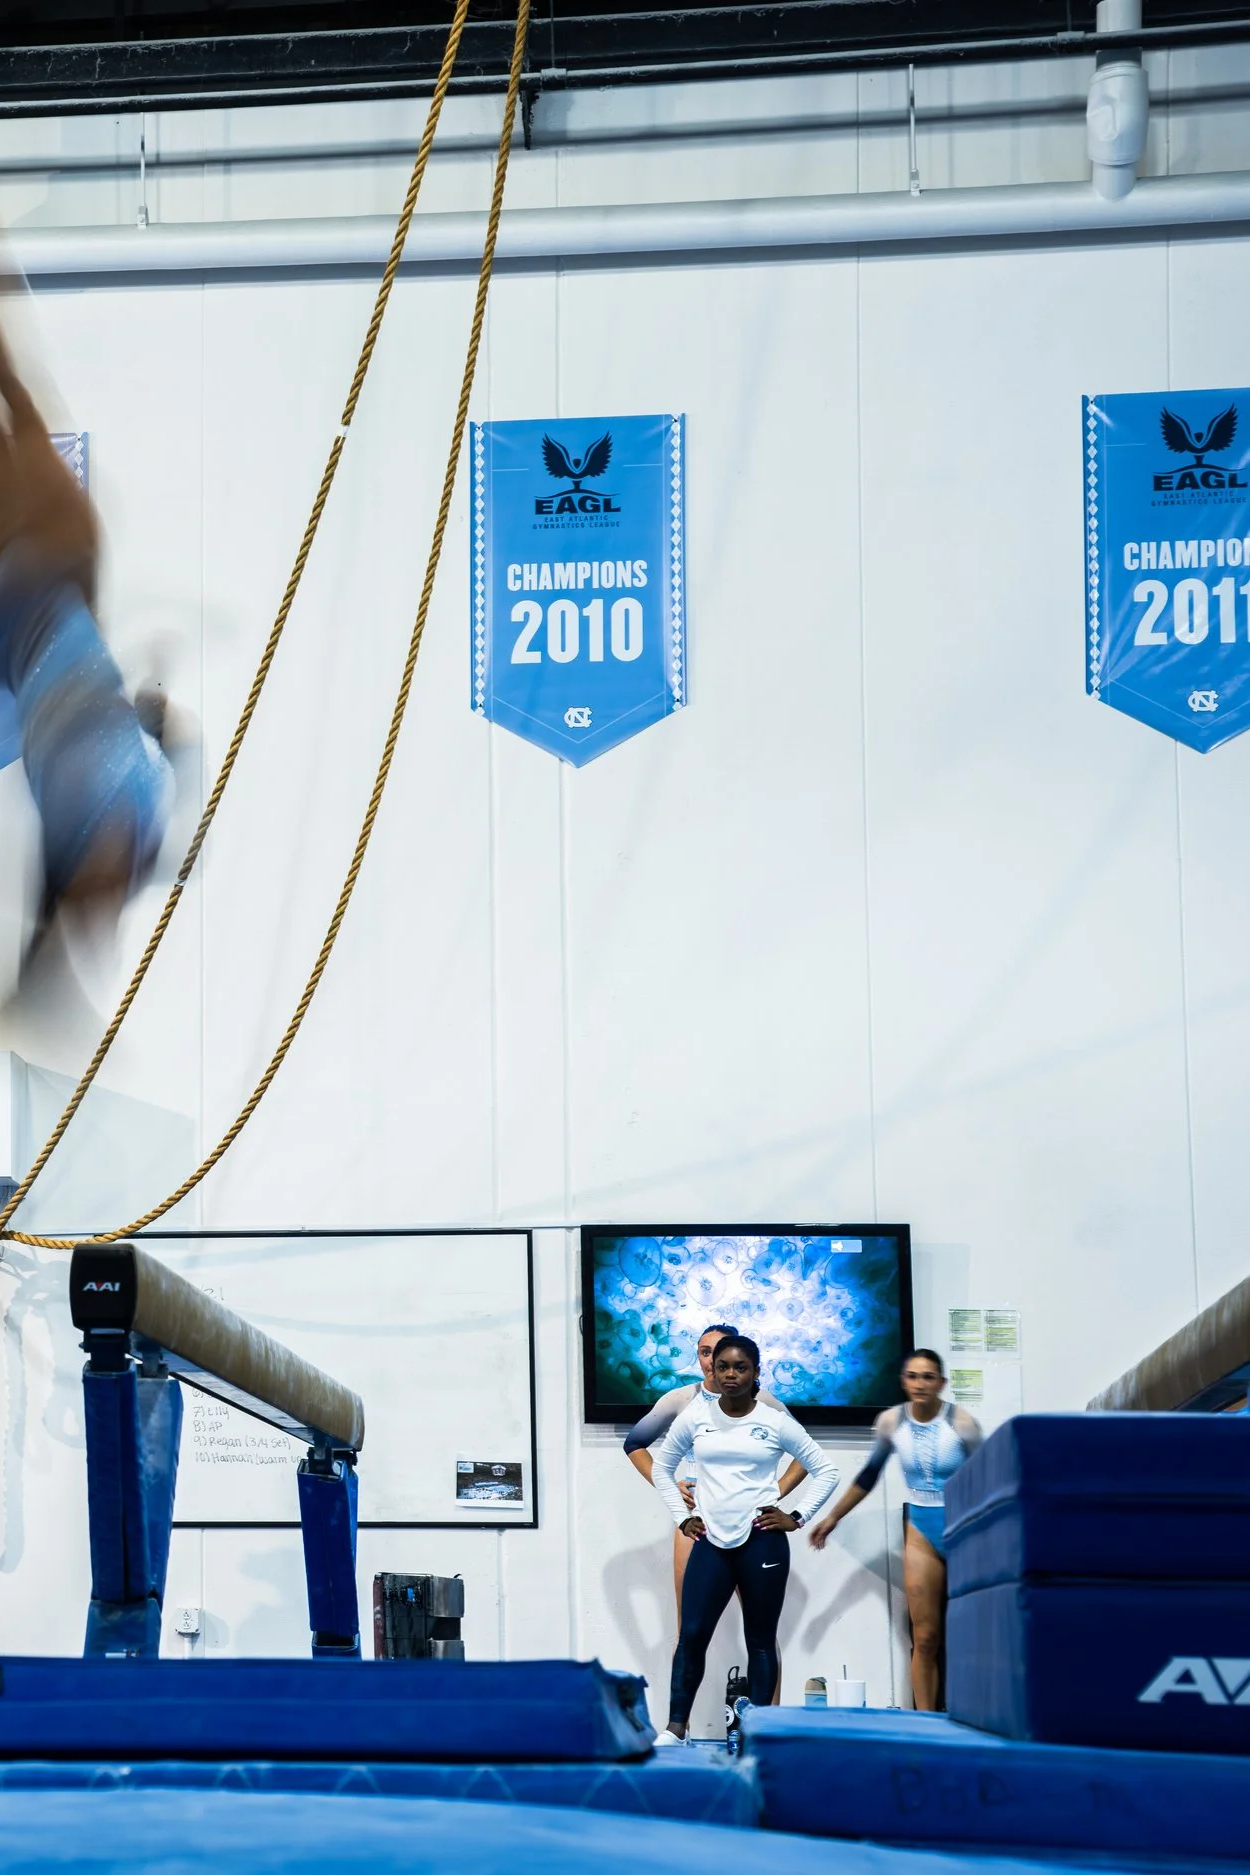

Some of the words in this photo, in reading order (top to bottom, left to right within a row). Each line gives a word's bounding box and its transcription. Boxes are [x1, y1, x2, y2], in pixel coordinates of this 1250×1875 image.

[1153, 472, 1248, 492] EAGL
[535, 498, 621, 515] EAGL
[1151, 499, 1208, 507] GYMNASTICS
[532, 522, 586, 530] GYMNASTICS
[507, 560, 648, 591] CHAMPIONS
[510, 597, 644, 664] 2010
